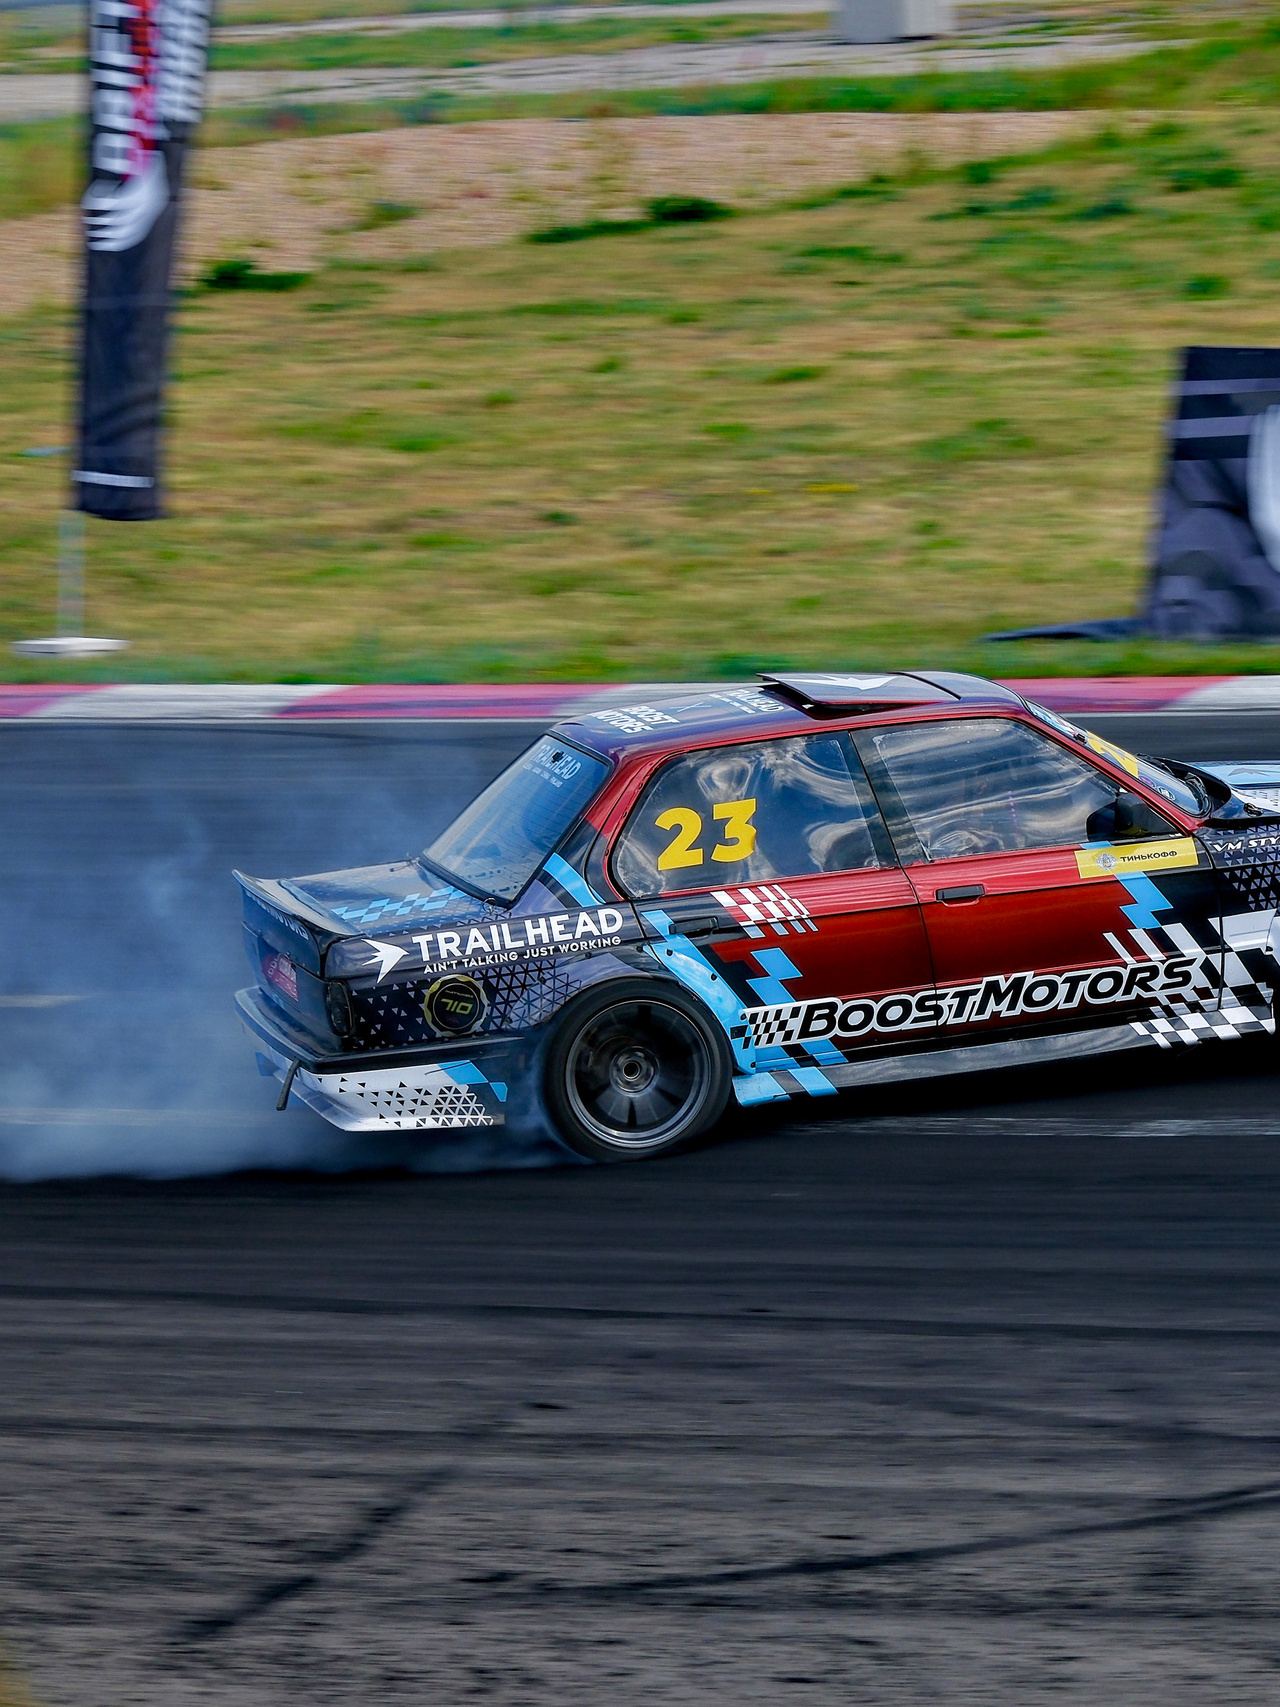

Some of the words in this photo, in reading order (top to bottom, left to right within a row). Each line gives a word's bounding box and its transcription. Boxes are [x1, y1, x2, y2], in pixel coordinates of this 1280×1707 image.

[620, 705, 680, 725] BOOST
[529, 744, 582, 780] TRAILHEAD
[654, 798, 757, 871] 23
[1212, 841, 1242, 852] VM
[1120, 850, 1178, 863] ТИНЬКОФФ
[412, 908, 624, 962] TRAILHEAD
[423, 959, 458, 974] AIN'T
[461, 950, 519, 968] TALKING
[523, 946, 555, 959] JUST
[558, 935, 622, 955] WORKING
[441, 998, 474, 1015] 710
